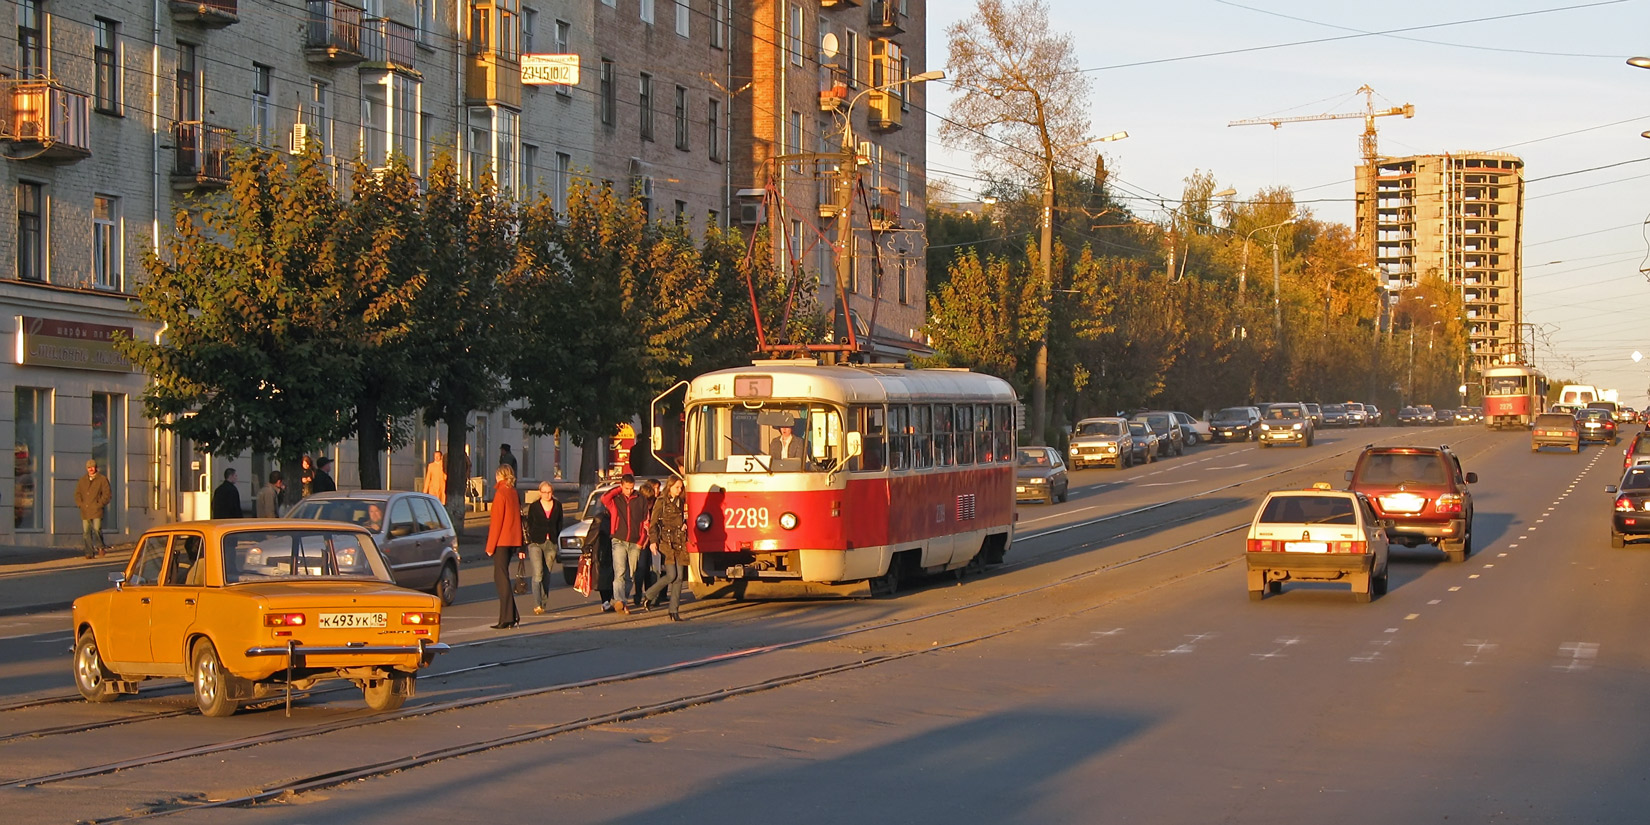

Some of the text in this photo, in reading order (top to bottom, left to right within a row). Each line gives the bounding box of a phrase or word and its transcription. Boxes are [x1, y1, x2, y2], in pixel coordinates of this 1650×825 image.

[748, 381, 759, 397] 5
[743, 457, 755, 473] 5
[724, 506, 770, 530] 2289
[372, 613, 383, 623] 18
